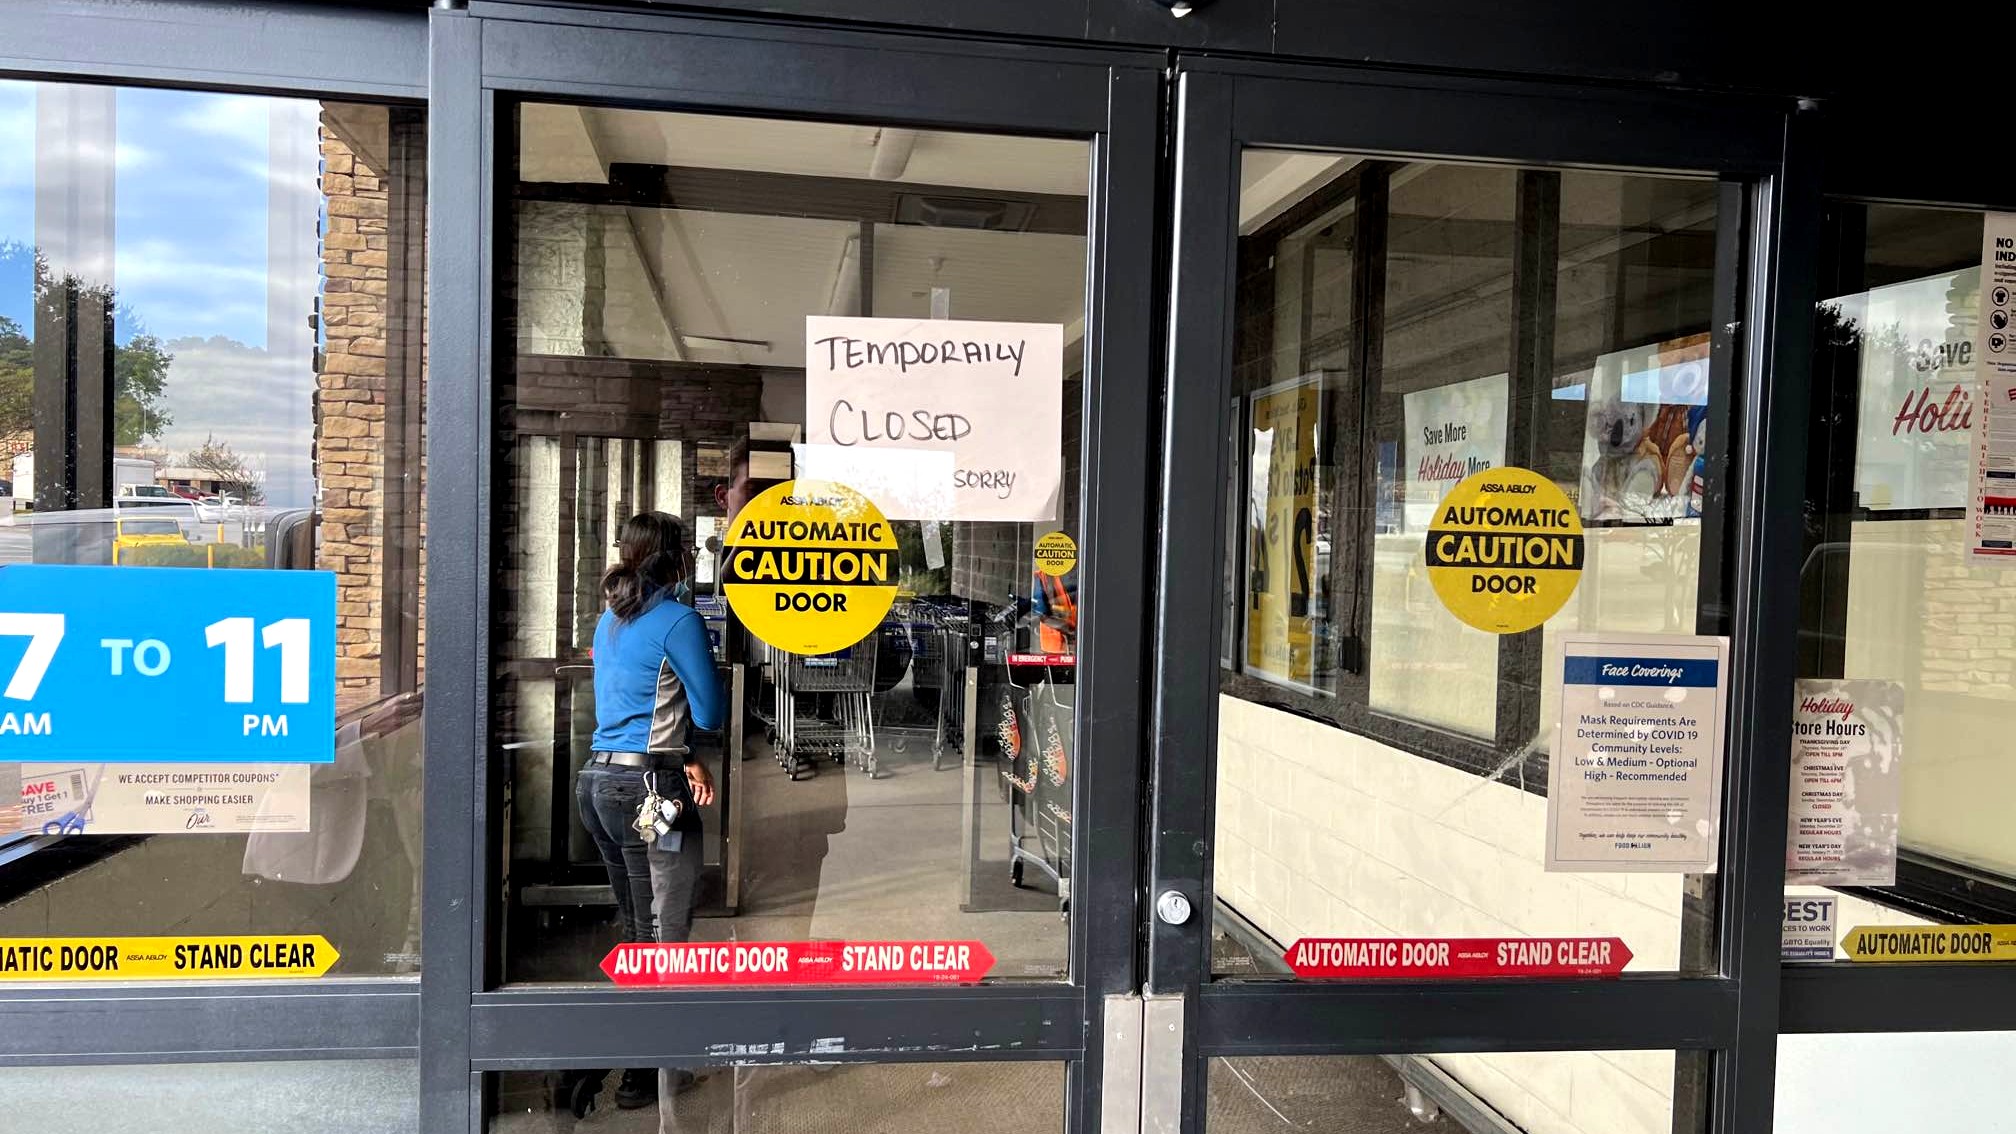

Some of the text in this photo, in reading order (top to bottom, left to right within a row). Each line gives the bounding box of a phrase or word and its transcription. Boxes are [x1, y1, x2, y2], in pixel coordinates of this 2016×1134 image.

[1995, 237, 2014, 249] NO
[813, 335, 1026, 377] TEMPORAILY
[829, 400, 972, 446] CLOSED
[1423, 423, 1467, 446] Save More
[1418, 453, 1490, 483] Holiday More
[953, 469, 1017, 500] SORRY
[1480, 484, 1536, 494] ASSA ABLOY
[1443, 506, 1570, 527] AUTOMATIC
[741, 520, 882, 542] AUTOMATIC
[1036, 550, 1075, 559] CAUTION
[1436, 535, 1574, 565] CAUTION
[733, 550, 888, 582] CAUTION
[1472, 575, 1537, 594] DOOR
[775, 592, 847, 612] DOOR
[0, 612, 310, 703] 7 TO 11
[1602, 663, 1684, 683] Face Coverings
[1800, 697, 1854, 721] Holiday
[0, 712, 289, 737] AM PM
[1580, 715, 1697, 727] Mask Requirements Are
[1826, 719, 1865, 736] Hours
[1577, 729, 1698, 741] Determined by COVID 19
[1591, 743, 1682, 755] Community Levels:
[1575, 757, 1594, 767] Low
[1596, 757, 1605, 767] &
[1606, 757, 1647, 767] Medium
[1656, 758, 1697, 769] Optional
[118, 774, 133, 783] WE
[135, 774, 170, 784] ACCEPT
[172, 773, 231, 784] COMPETITOR
[1584, 771, 1607, 782] High
[1616, 771, 1687, 781] Recommended
[21, 781, 56, 796] AVE
[21, 796, 35, 804] uy
[44, 793, 61, 801] Get
[145, 794, 254, 805] MAKE SHOPPING EASIER
[186, 812, 210, 829] Our
[1783, 901, 1832, 921] EST
[1804, 938, 1830, 947] Equality
[1856, 932, 1945, 955] AUTOMATIC
[1950, 932, 1992, 954] DOOR
[0, 945, 53, 972] ATIC
[60, 945, 119, 971] DOOR
[174, 943, 243, 970] STAND
[249, 942, 316, 968] CLEAR
[614, 946, 730, 974] AUTOMATIC
[735, 946, 789, 972] DOOR
[842, 945, 905, 971] STAND
[909, 945, 970, 971] CLEAR
[1295, 942, 1397, 967] AUTOMATIC
[1402, 942, 1449, 967] DOOR
[1496, 941, 1553, 966] STAND
[1557, 941, 1611, 965] CLEAR
